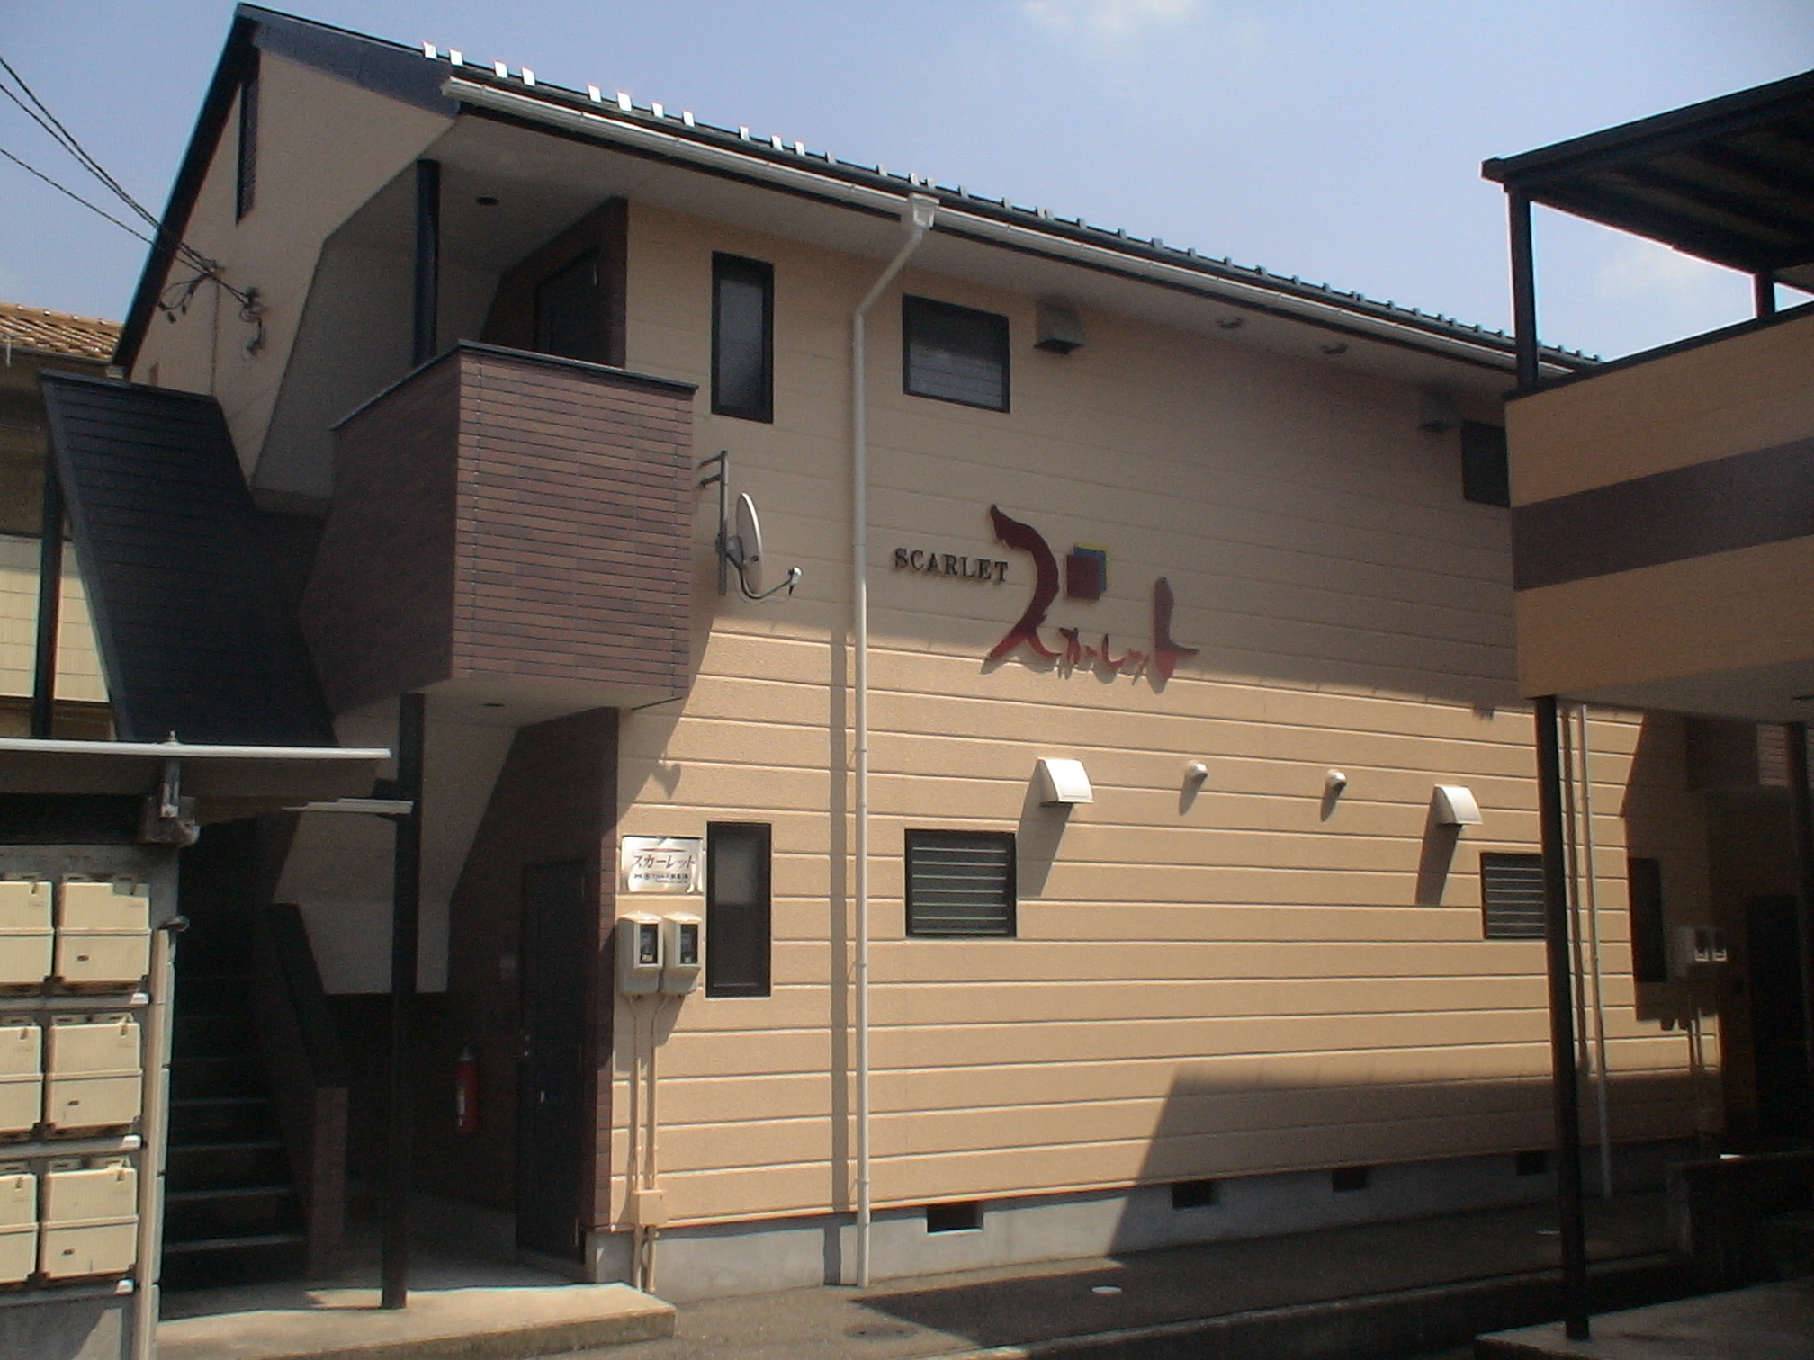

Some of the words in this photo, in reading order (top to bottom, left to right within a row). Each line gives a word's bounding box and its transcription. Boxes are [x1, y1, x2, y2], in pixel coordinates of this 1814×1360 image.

[894, 548, 1008, 583] SCARLET
[632, 854, 696, 869] スカーレット
